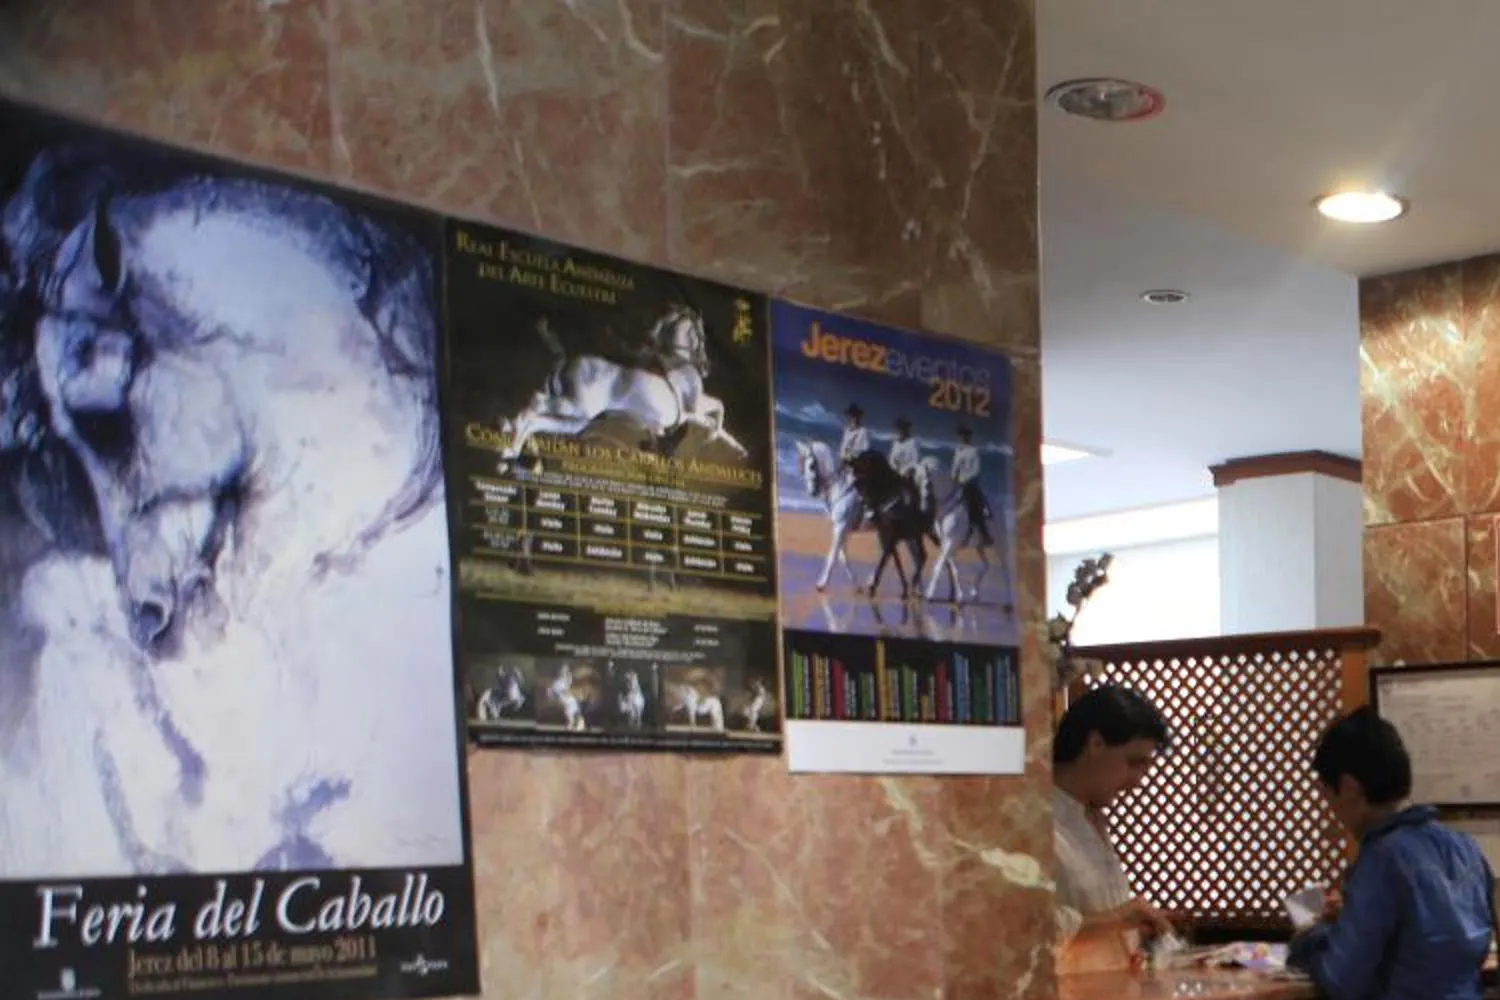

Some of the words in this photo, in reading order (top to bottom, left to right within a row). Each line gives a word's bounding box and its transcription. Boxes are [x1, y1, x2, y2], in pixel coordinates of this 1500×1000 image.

[928, 375, 991, 417] 2012
[33, 885, 178, 949] Feria
[194, 878, 266, 940] del
[276, 872, 445, 934] Caballo
[176, 945, 203, 974] del
[334, 934, 377, 960] 2011
